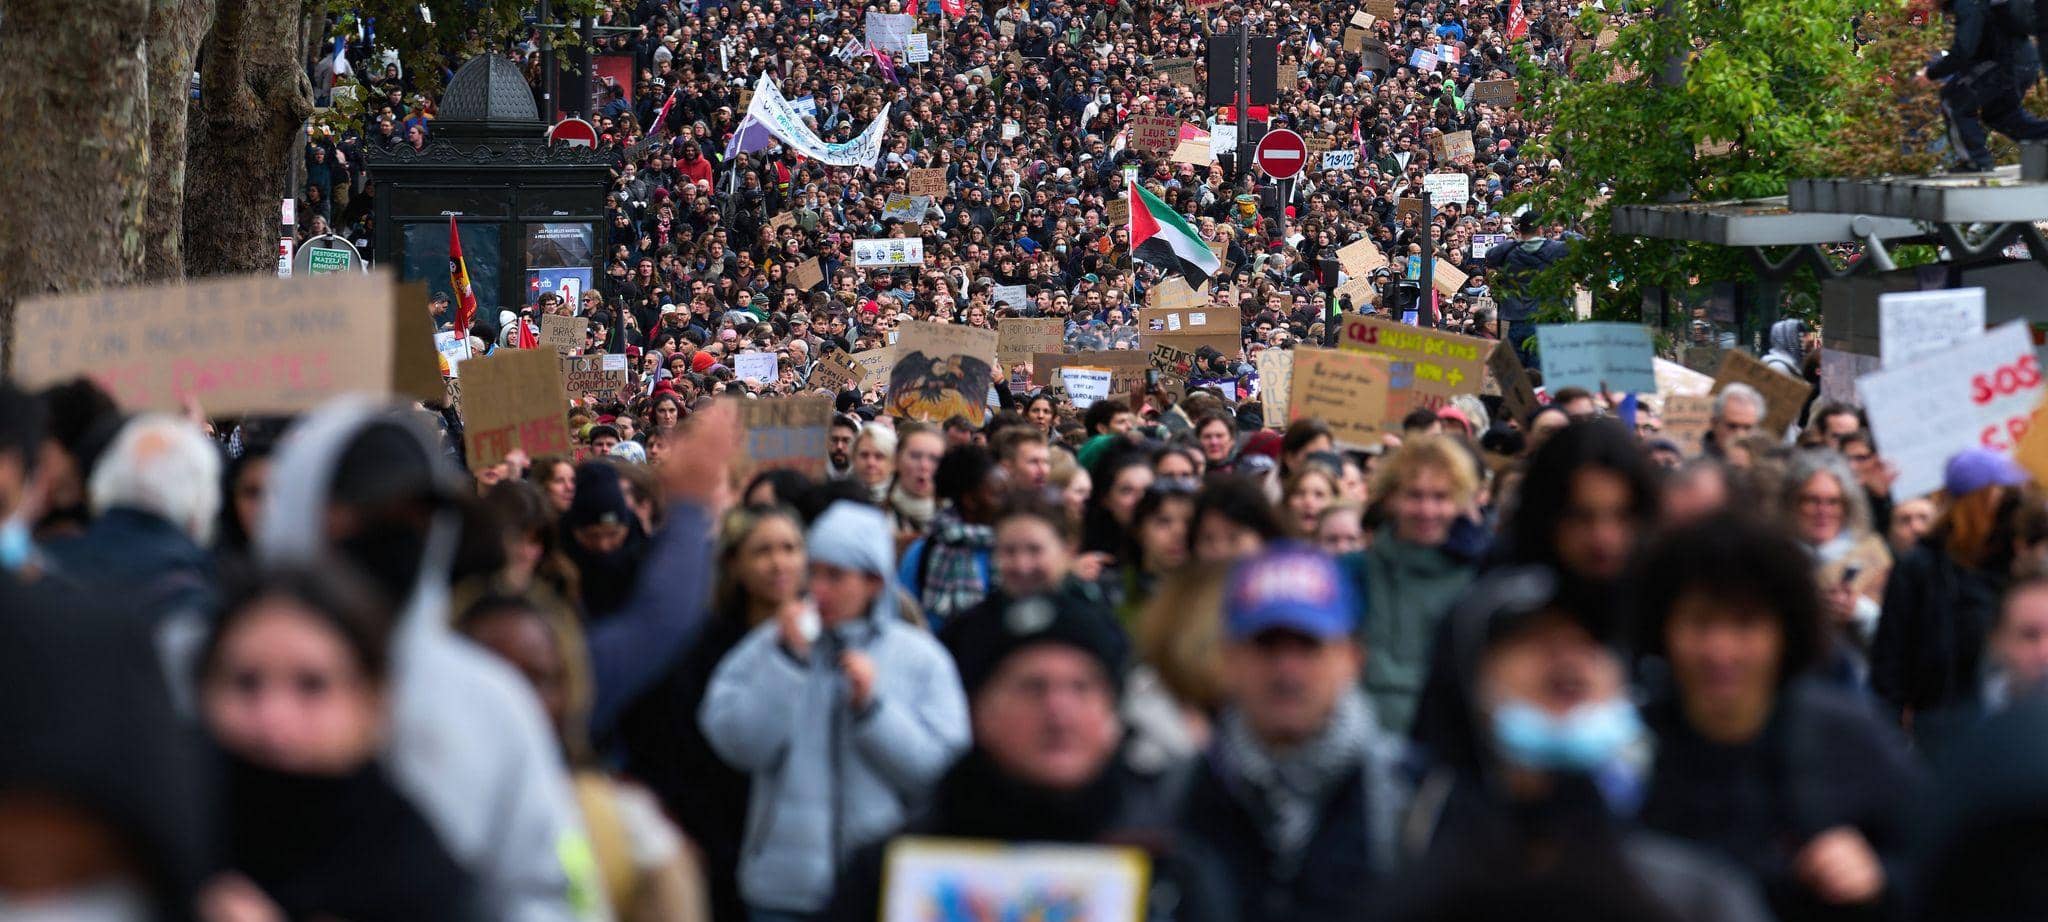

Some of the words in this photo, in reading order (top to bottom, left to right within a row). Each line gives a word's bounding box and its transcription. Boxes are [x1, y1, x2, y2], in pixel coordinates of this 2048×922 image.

[1137, 117, 1149, 125] LA
[1152, 117, 1165, 126] FIN
[1166, 118, 1177, 127] DE
[1143, 128, 1166, 138] LEUR
[1140, 138, 1168, 148] MONDE
[1326, 151, 1354, 166] 1312
[552, 326, 576, 338] BRAS
[1347, 321, 1379, 345] CRS
[571, 357, 599, 372] TOUS
[568, 370, 604, 381] CONTRE
[605, 370, 618, 381] LA
[1970, 354, 2042, 406] SOS
[566, 379, 622, 392] CORRUPTION
